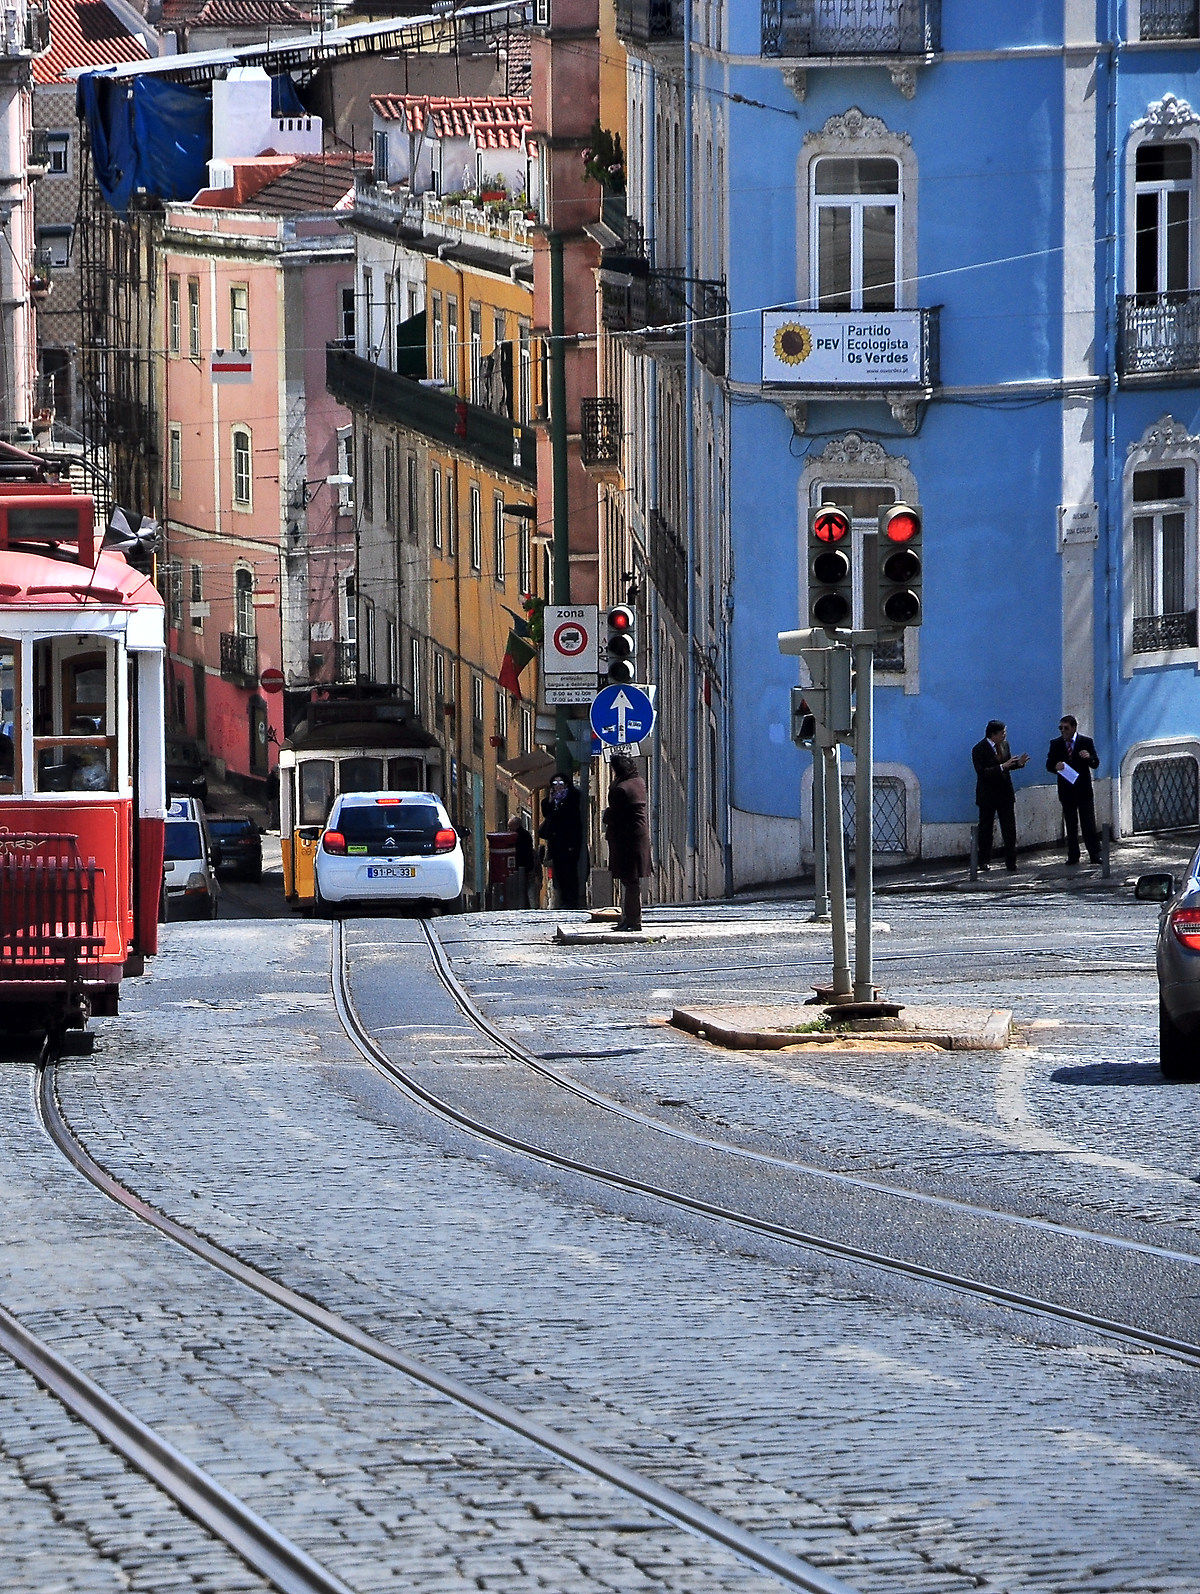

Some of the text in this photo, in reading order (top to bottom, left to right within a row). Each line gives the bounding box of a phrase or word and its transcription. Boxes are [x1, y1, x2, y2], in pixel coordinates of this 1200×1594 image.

[847, 325, 891, 336] Partido
[816, 339, 840, 350] PEV
[847, 338, 909, 352] Ecologista
[847, 352, 909, 363] Os Verdes
[557, 609, 584, 618] zona
